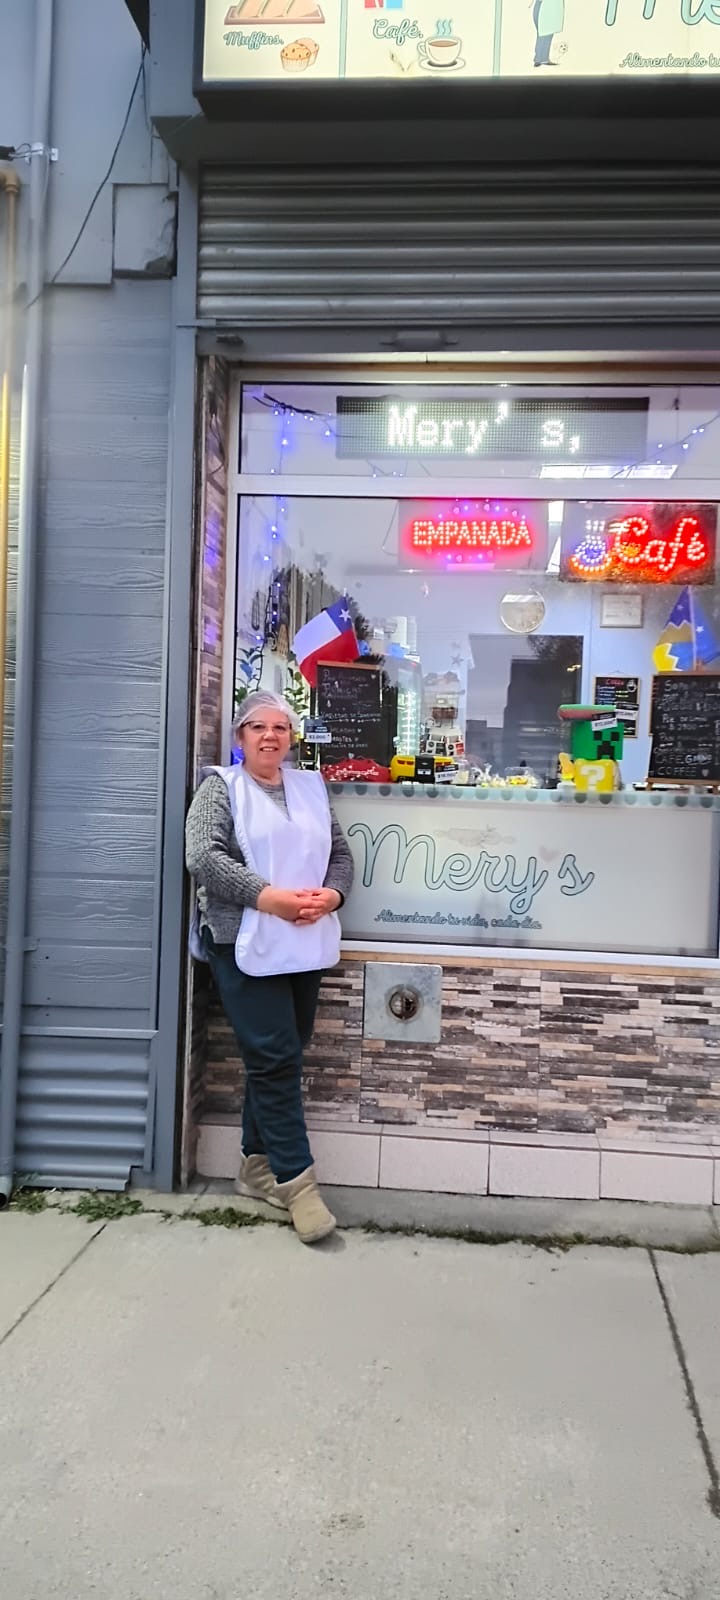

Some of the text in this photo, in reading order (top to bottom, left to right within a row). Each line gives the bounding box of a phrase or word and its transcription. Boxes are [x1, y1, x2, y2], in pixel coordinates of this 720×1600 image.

[619, 52, 708, 68] Alimentando
[413, 520, 532, 545] EMPANADA
[612, 516, 706, 571] Café
